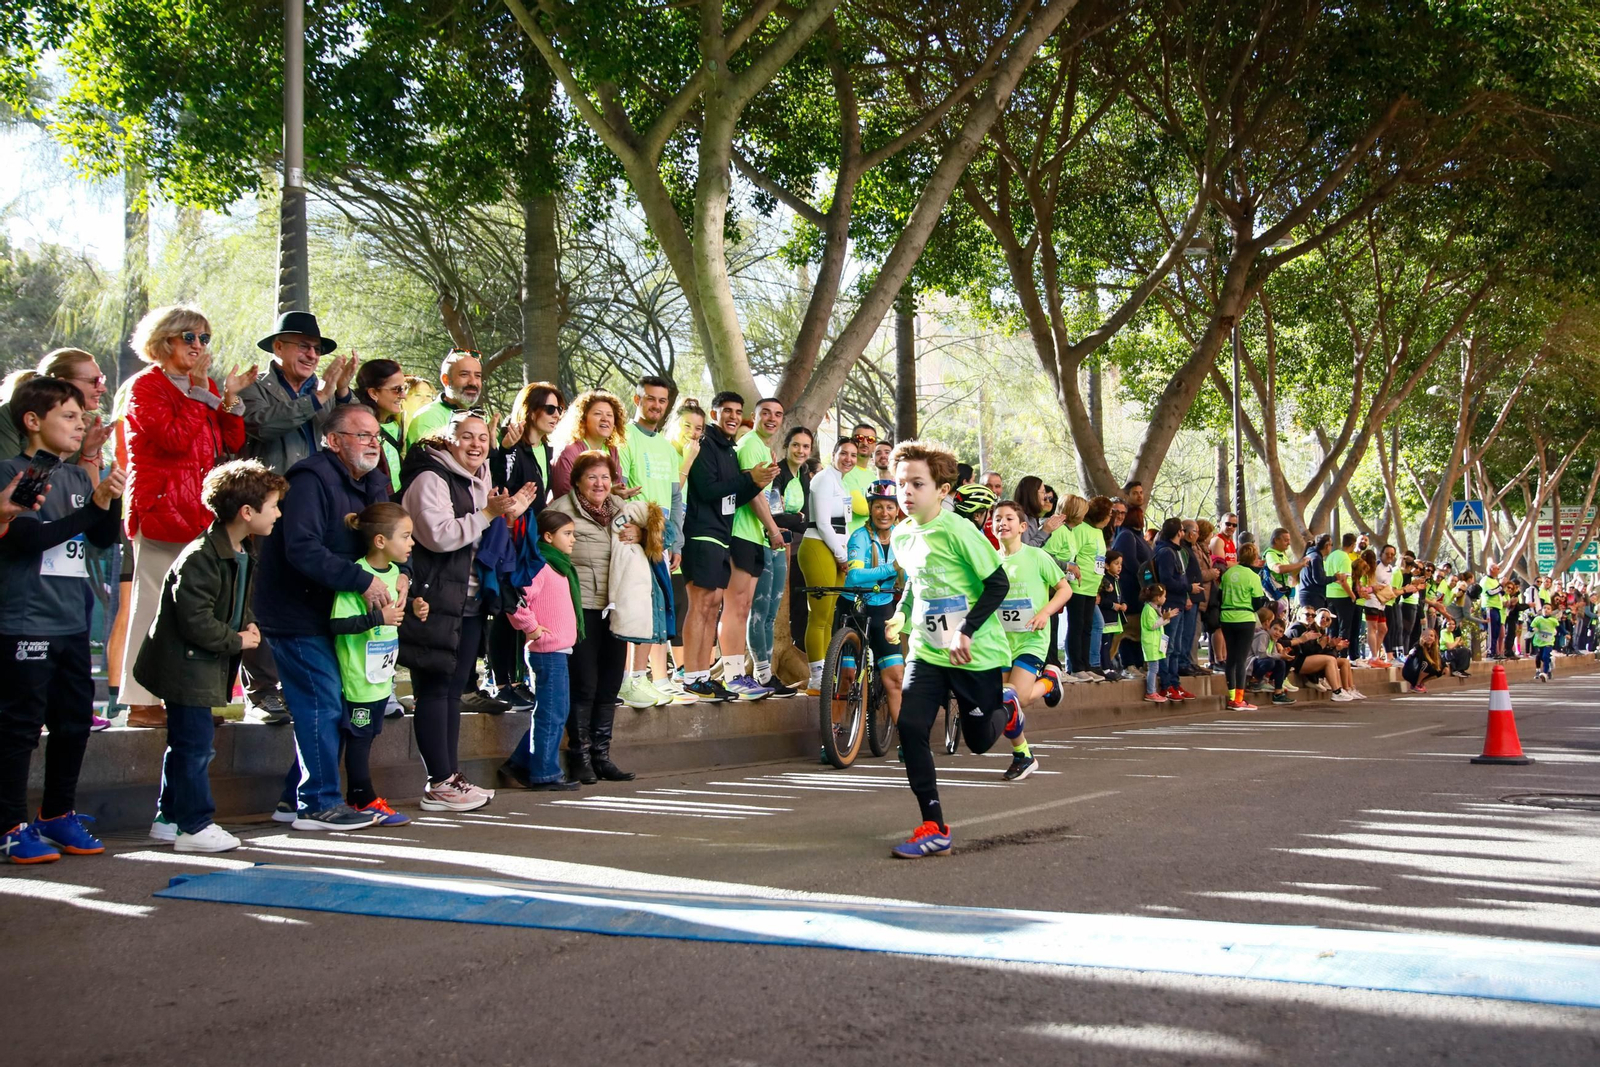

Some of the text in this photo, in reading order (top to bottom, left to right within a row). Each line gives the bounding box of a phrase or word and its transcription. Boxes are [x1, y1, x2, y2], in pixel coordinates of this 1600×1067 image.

[66, 541, 84, 559] 93
[925, 614, 948, 632] 51
[1002, 610, 1021, 622] 52
[381, 652, 394, 669] 24
